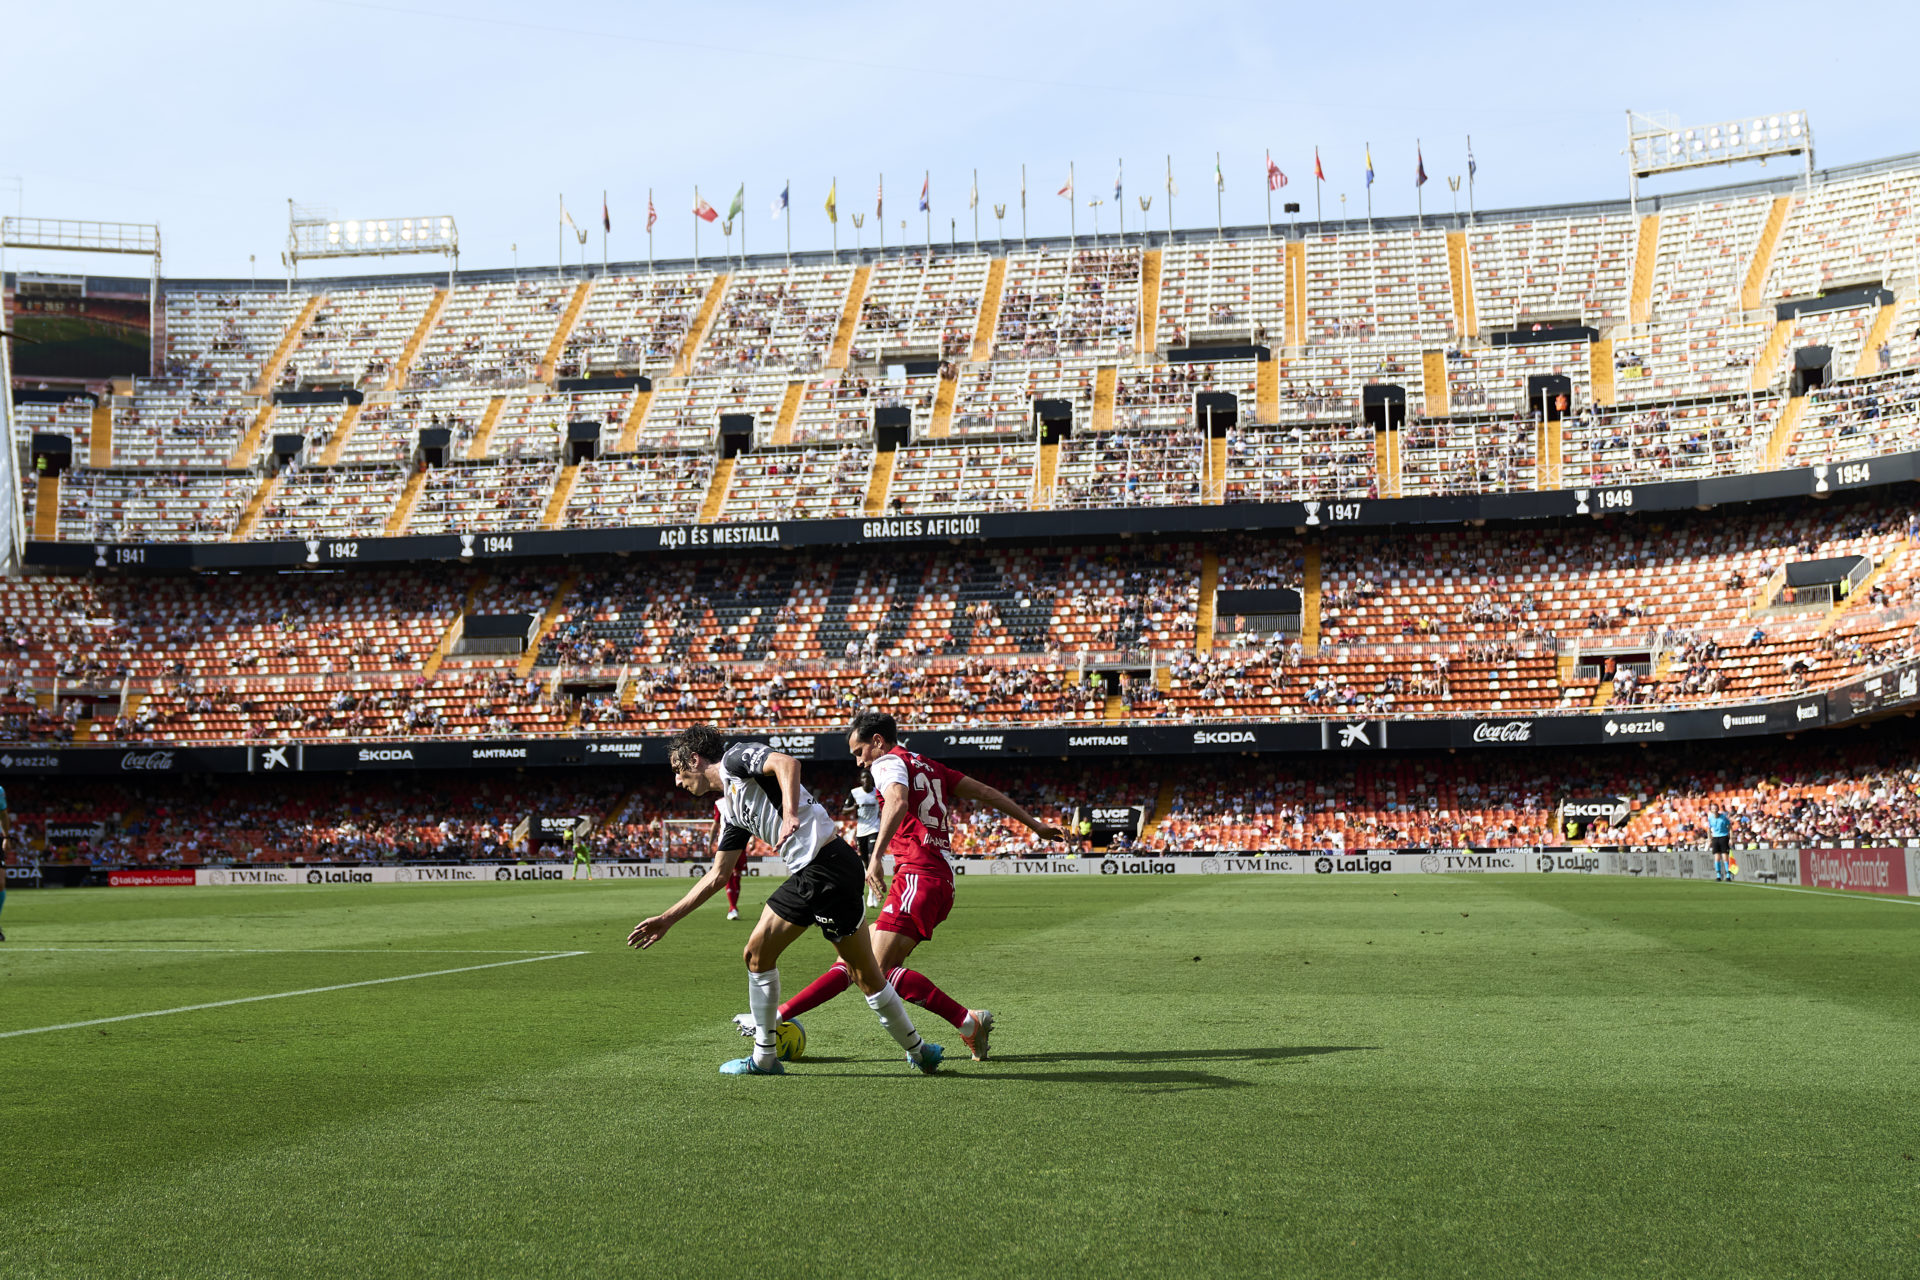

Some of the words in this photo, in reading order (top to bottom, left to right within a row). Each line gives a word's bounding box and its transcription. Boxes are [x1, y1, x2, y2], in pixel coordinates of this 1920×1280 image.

[1836, 463, 1870, 484] 1954
[1597, 489, 1633, 508] 1949
[1327, 502, 1361, 520] 1947
[862, 518, 922, 538] GRÀCIES
[927, 514, 980, 535] AFICIÓ!
[659, 526, 686, 549] AÇÒ
[690, 524, 709, 545] ÉS
[713, 526, 780, 544] MESTALLA
[328, 542, 358, 558] 1942
[482, 536, 513, 553] 1944
[115, 548, 145, 564] 1941
[1619, 718, 1665, 734] sezzle
[958, 735, 1004, 745] SAILUN
[1068, 735, 1128, 746] SAMTRADE
[1193, 731, 1256, 743] ŠKODA
[472, 748, 527, 759] SAMTRADE
[599, 743, 642, 752] SAILUN
[15, 756, 59, 767] sezzle
[358, 749, 414, 761] ŠKODA
[914, 772, 948, 831] 21
[1013, 862, 1048, 873] TVM
[1052, 862, 1079, 873] Inc.
[1122, 860, 1175, 874] LaLiga
[1223, 859, 1261, 871] TVM
[1265, 859, 1292, 870] Inc.
[1336, 857, 1392, 873] LaLiga
[1443, 856, 1482, 868] TVM
[1486, 856, 1515, 868] Inc.
[1557, 854, 1599, 872] LaLiga
[6, 868, 42, 878] ODA
[229, 871, 261, 883] TVM
[264, 871, 288, 882] Inc.
[325, 869, 373, 883] LaLiga
[415, 869, 448, 880] TVM
[452, 869, 476, 880] Inc.
[514, 867, 563, 881] LaLiga
[609, 866, 641, 877] TVM
[644, 866, 669, 877] Inc.
[1817, 855, 1839, 888] LaLiga
[1849, 853, 1890, 888] Santander
[119, 876, 146, 886] LaLiga
[152, 873, 193, 885] Santander
[815, 914, 835, 924] ODA
